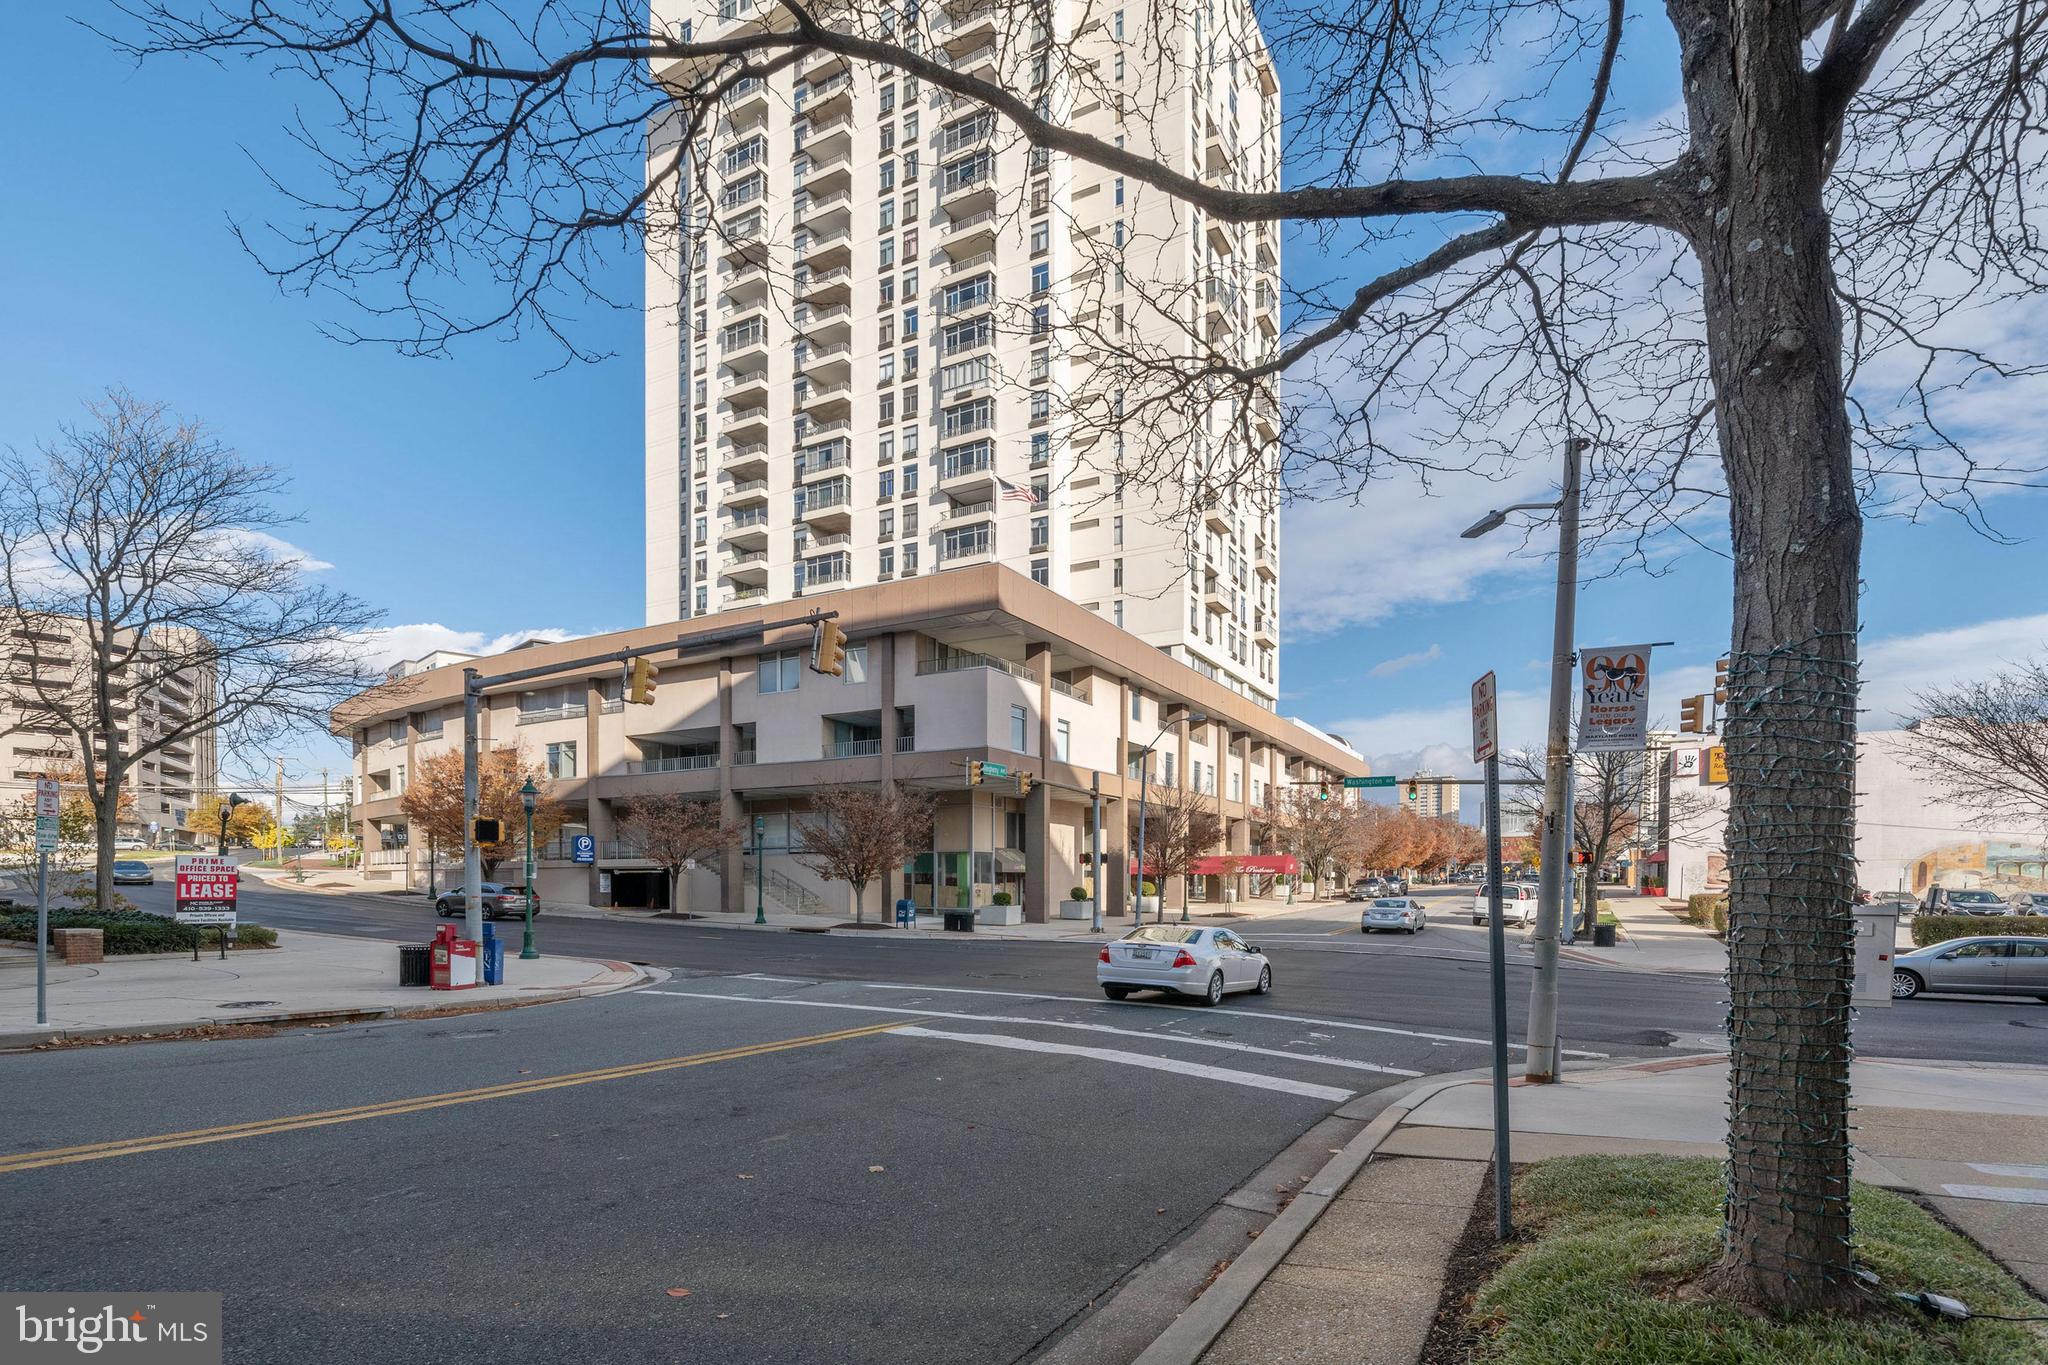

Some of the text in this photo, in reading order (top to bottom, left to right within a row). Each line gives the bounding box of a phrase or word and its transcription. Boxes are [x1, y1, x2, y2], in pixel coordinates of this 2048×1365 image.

[1585, 653, 1646, 692] 90
[1478, 683, 1487, 699] NO
[1585, 687, 1645, 703] Years
[1473, 696, 1493, 719] PARKING
[1590, 705, 1636, 713] Horses
[1480, 717, 1488, 729] ANY
[1589, 717, 1636, 726] Legacy
[1480, 728, 1489, 739] TIME
[1347, 778, 1382, 786] Washington
[38, 790, 58, 798] PARKING
[1245, 865, 1276, 873] Penthouse
[187, 874, 216, 882] PRICED
[181, 883, 234, 898] LEASE
